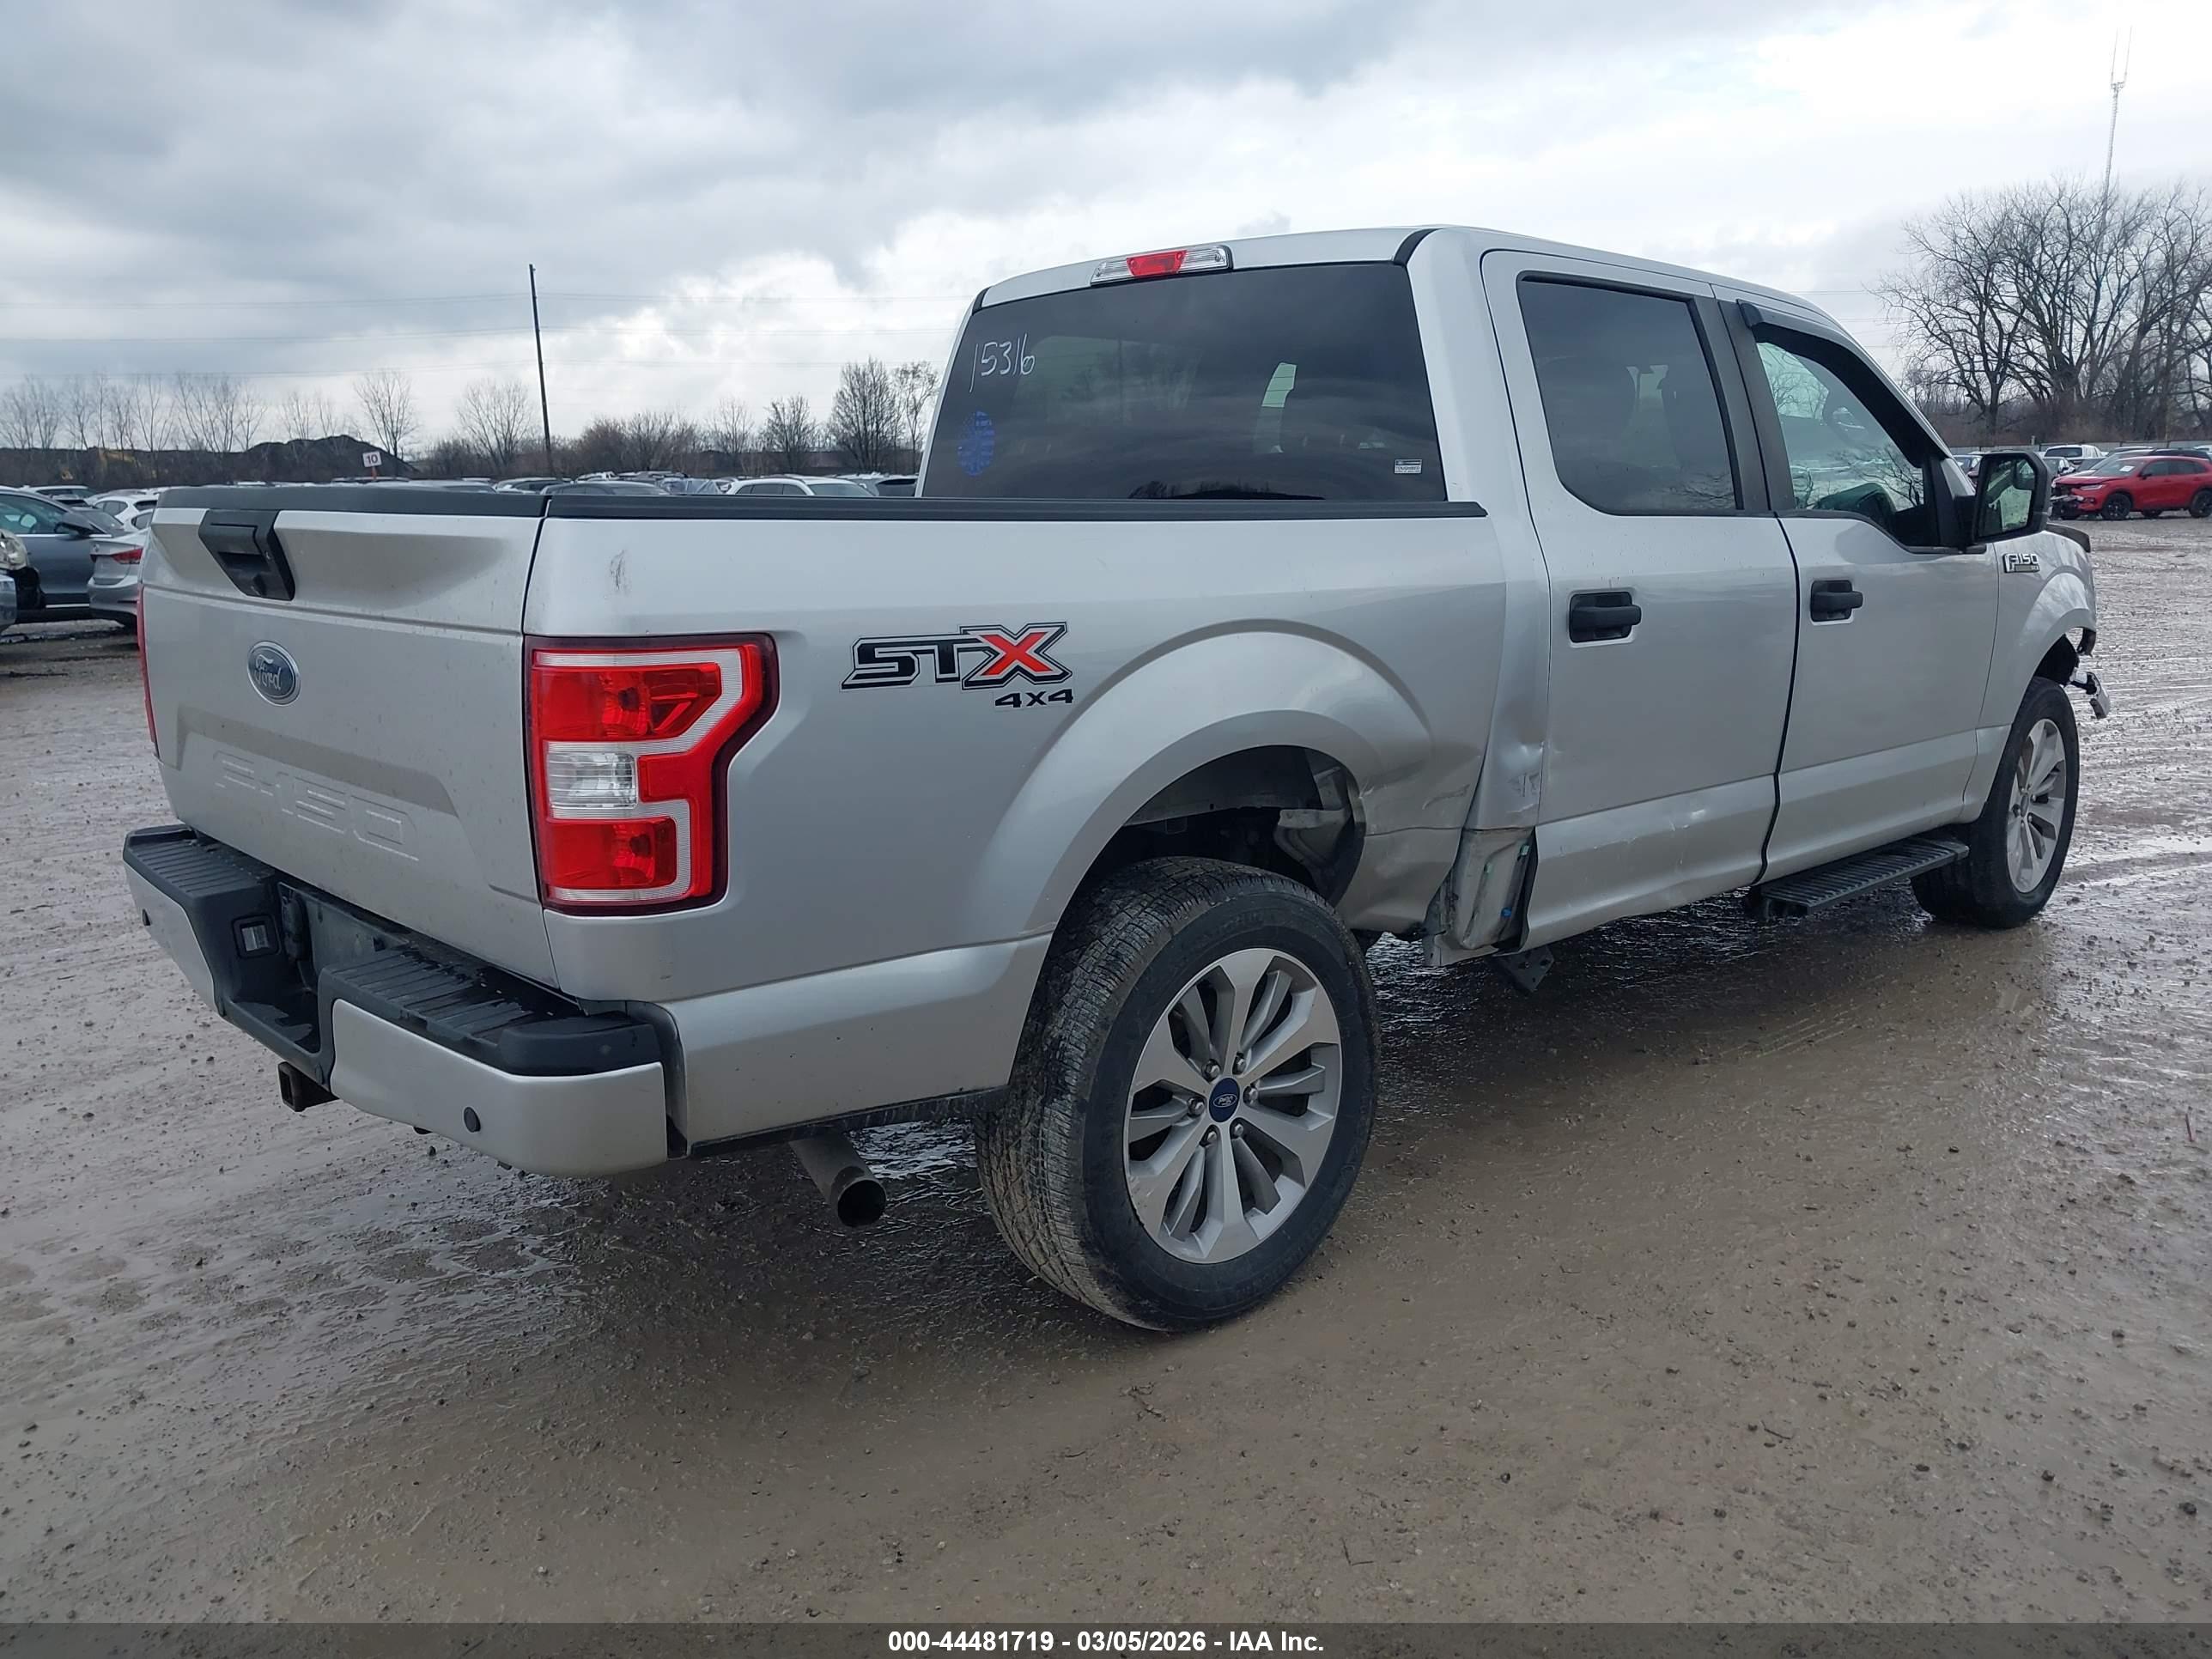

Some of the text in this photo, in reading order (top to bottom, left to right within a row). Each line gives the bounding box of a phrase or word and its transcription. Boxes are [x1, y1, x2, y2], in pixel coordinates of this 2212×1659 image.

[969, 333, 1035, 392] 15316
[367, 454, 378, 465] 10
[254, 653, 282, 690] Ford
[842, 622, 1073, 690] STX
